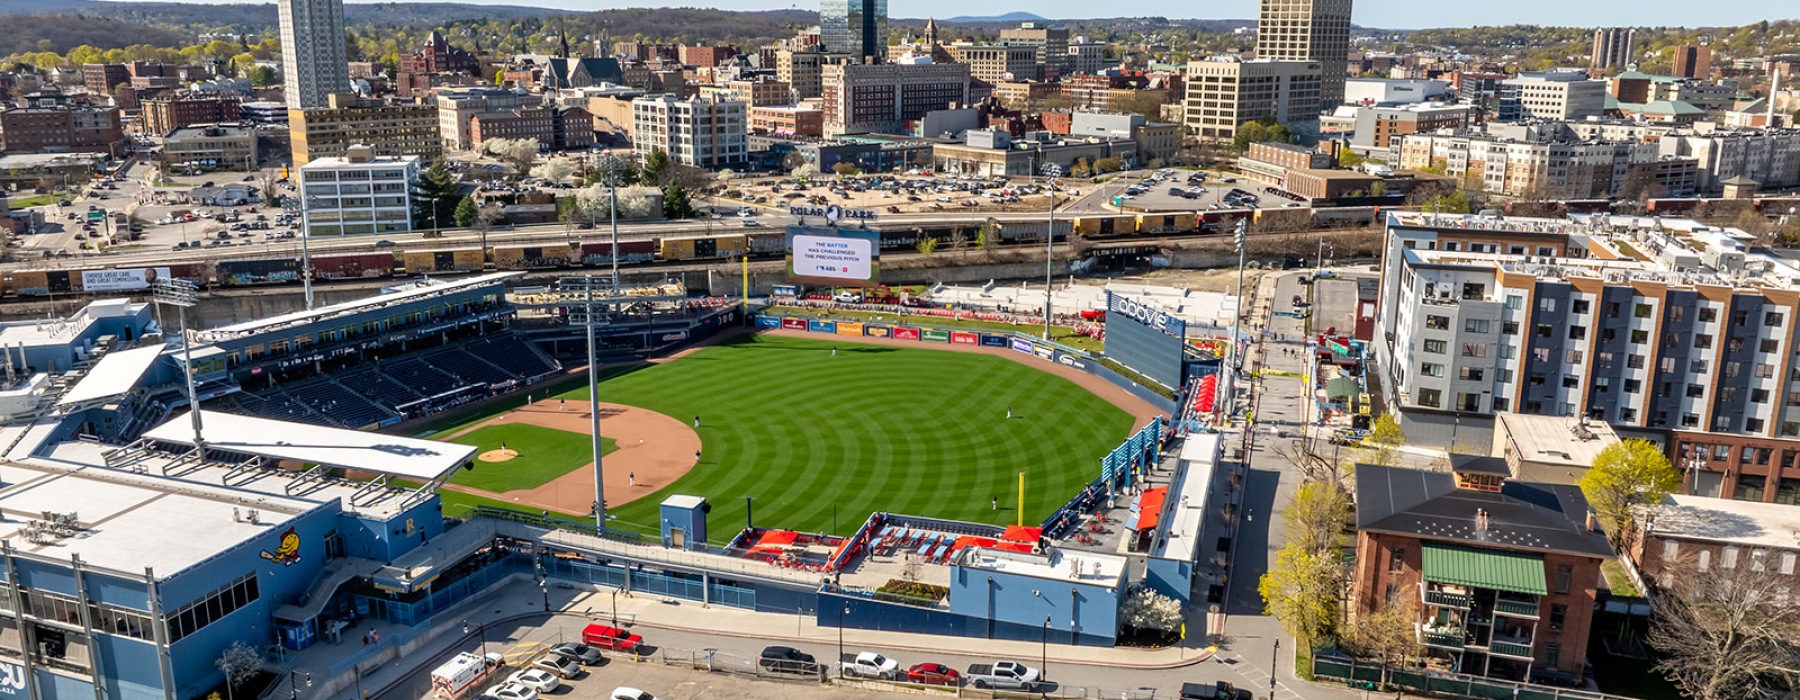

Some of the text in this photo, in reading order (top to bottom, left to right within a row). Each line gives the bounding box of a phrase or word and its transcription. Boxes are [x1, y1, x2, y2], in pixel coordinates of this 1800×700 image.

[790, 207, 874, 219] POLAR PARK
[1118, 299, 1167, 329] abbvie
